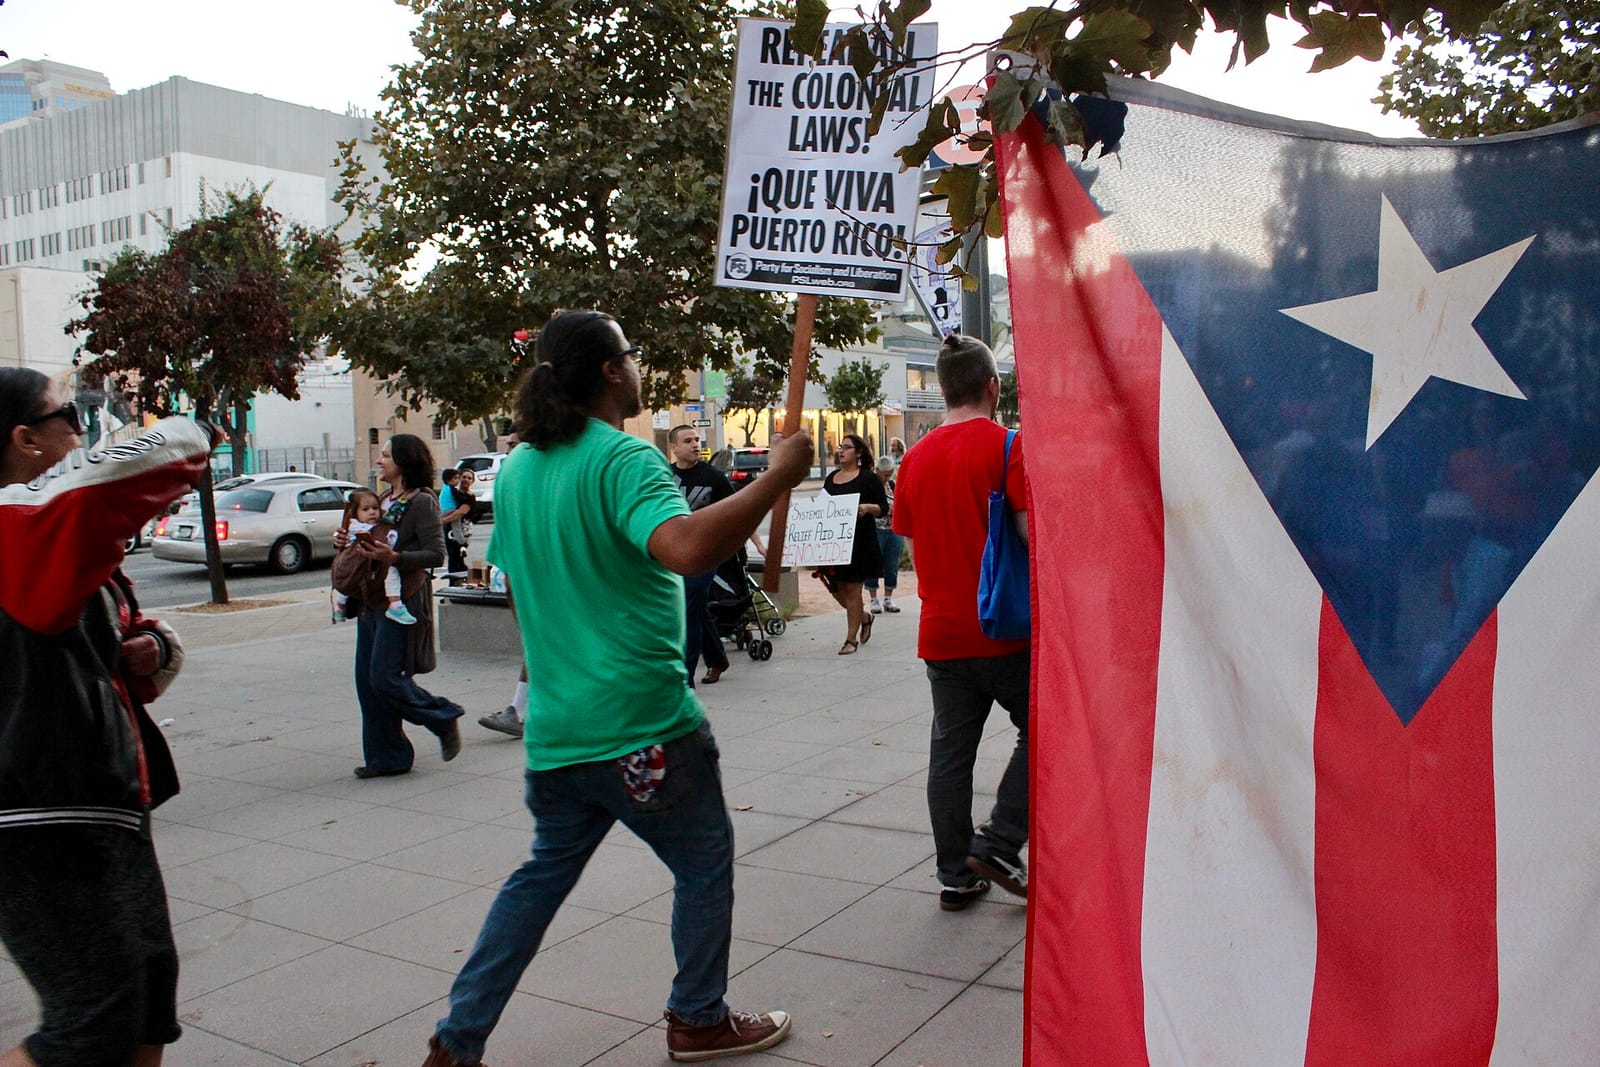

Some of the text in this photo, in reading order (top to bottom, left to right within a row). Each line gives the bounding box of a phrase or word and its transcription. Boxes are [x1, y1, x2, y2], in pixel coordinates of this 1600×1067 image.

[760, 26, 857, 66] REEA
[748, 72, 921, 112] THE COLONAL
[788, 115, 871, 154] LAWS!
[825, 169, 895, 213] VIVA
[730, 213, 906, 259] PUERTO RICO!
[730, 261, 749, 274] PSL
[755, 260, 897, 281] Party for Socialism and Liberation
